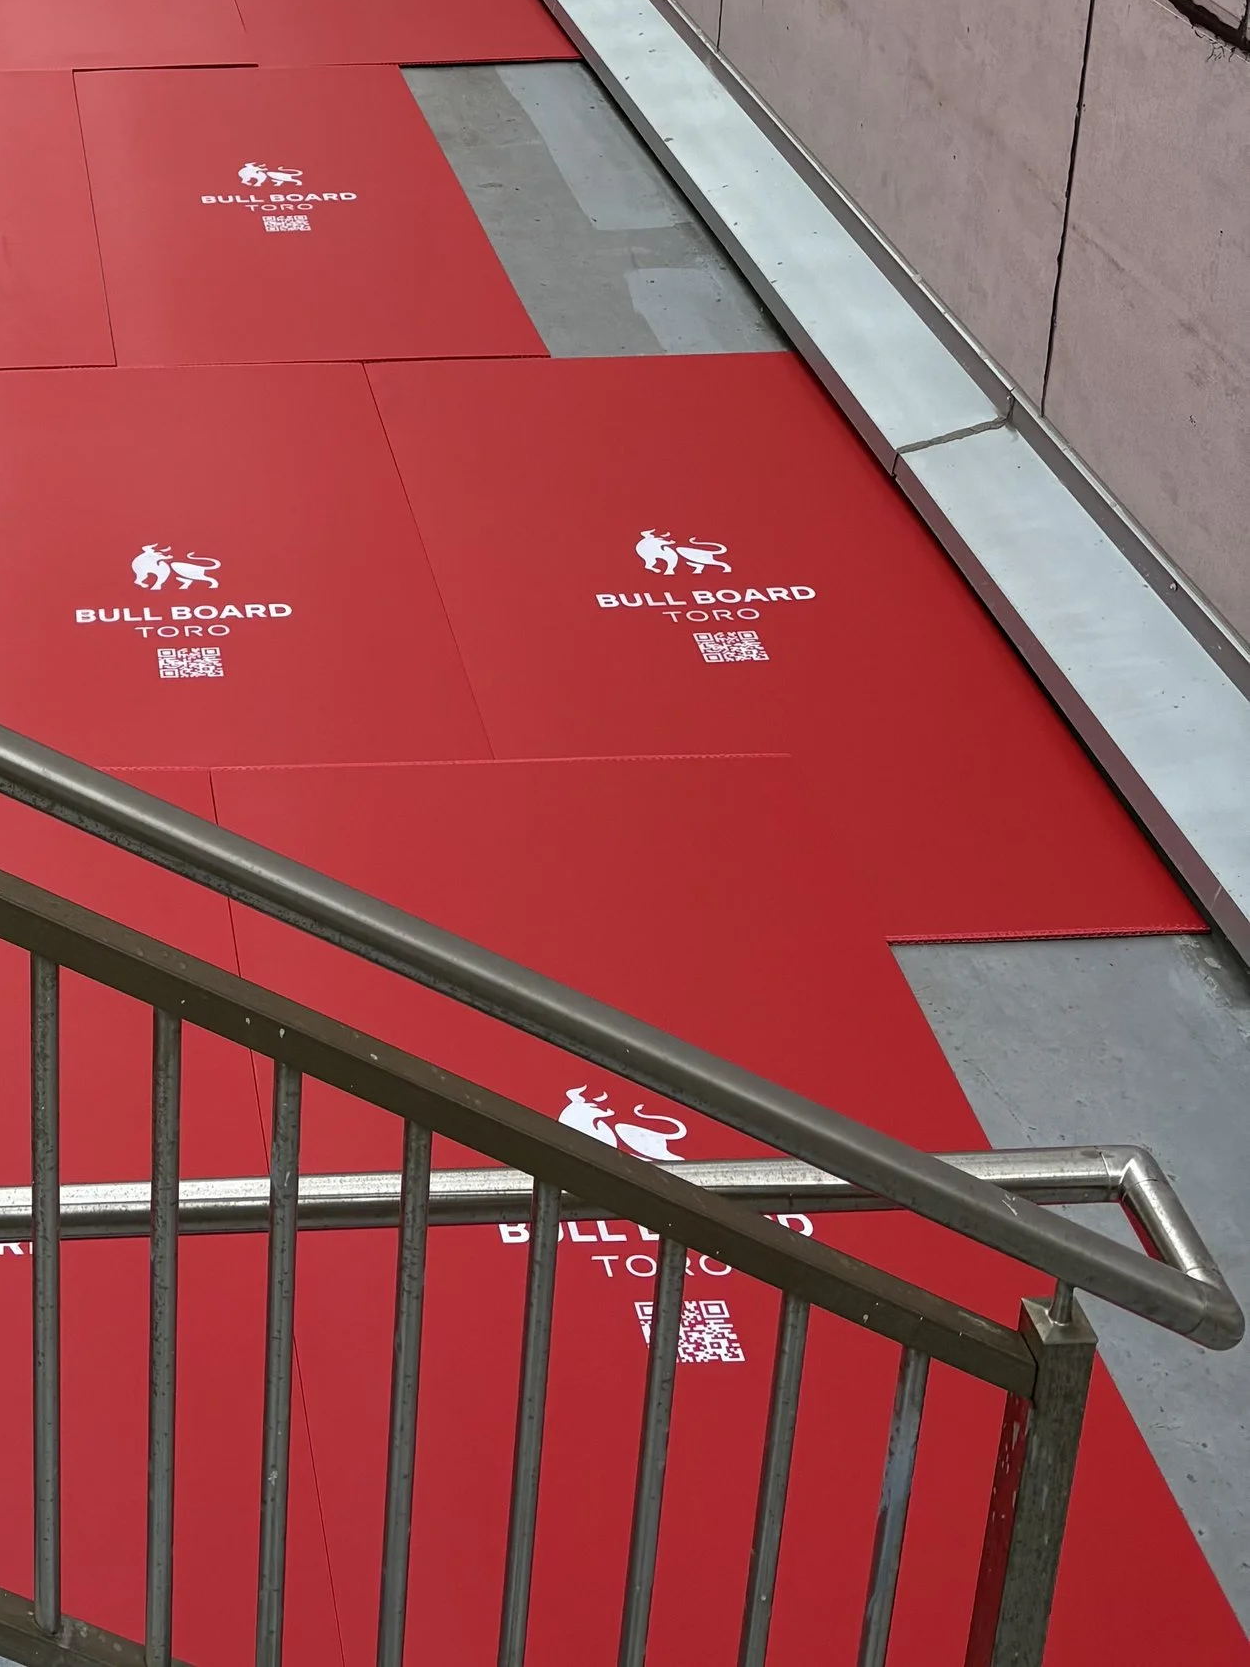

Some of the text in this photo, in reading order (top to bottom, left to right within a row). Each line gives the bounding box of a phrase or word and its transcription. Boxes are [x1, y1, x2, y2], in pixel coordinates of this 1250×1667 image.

[201, 192, 357, 204] BULL BOARD
[245, 203, 313, 211] TORO
[595, 586, 816, 608] BULL BOARD
[75, 603, 292, 623] BULL BOARD
[662, 608, 760, 622] TORO
[135, 624, 230, 638] TORO
[498, 1219, 627, 1244] BLL
